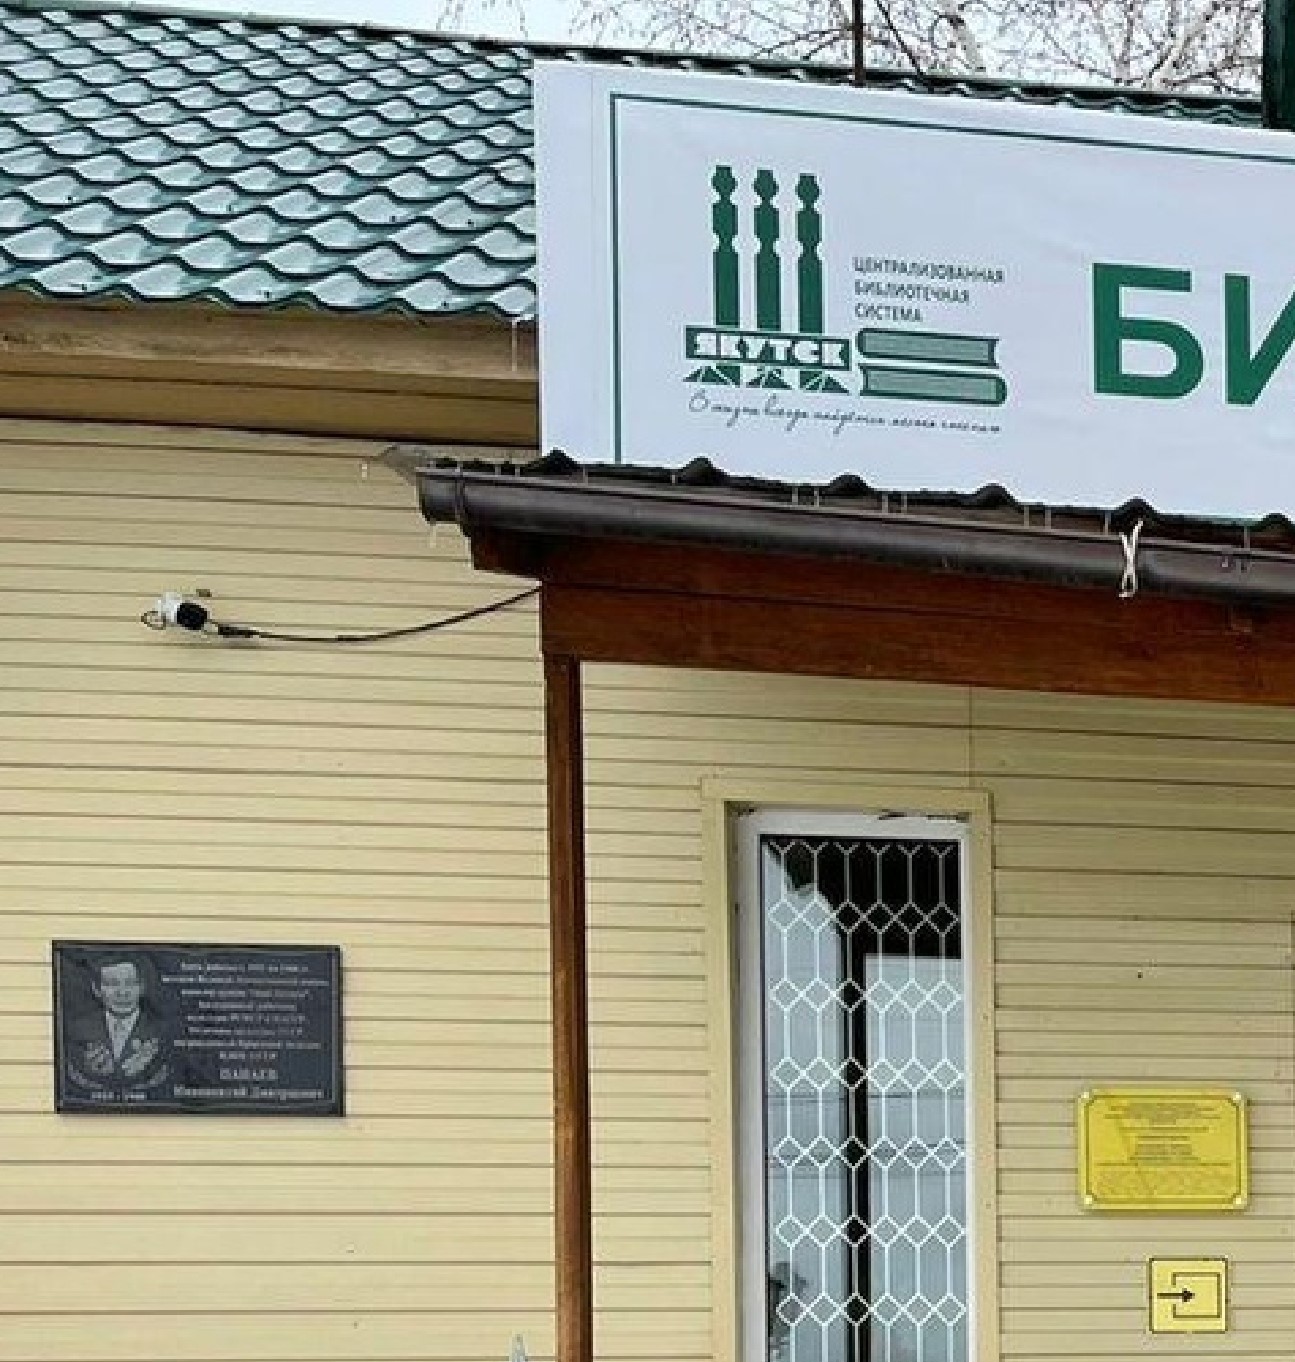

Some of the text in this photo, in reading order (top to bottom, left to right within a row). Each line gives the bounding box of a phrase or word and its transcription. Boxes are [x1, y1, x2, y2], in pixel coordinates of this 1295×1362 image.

[853, 257, 1004, 283] ЦЕНТРАЛИЗОВАННАЯ
[854, 279, 970, 305] БИБЛИОТЕЧНАЯ
[854, 302, 923, 323] СИСТЕМА
[694, 332, 846, 367] ЯКУТСК
